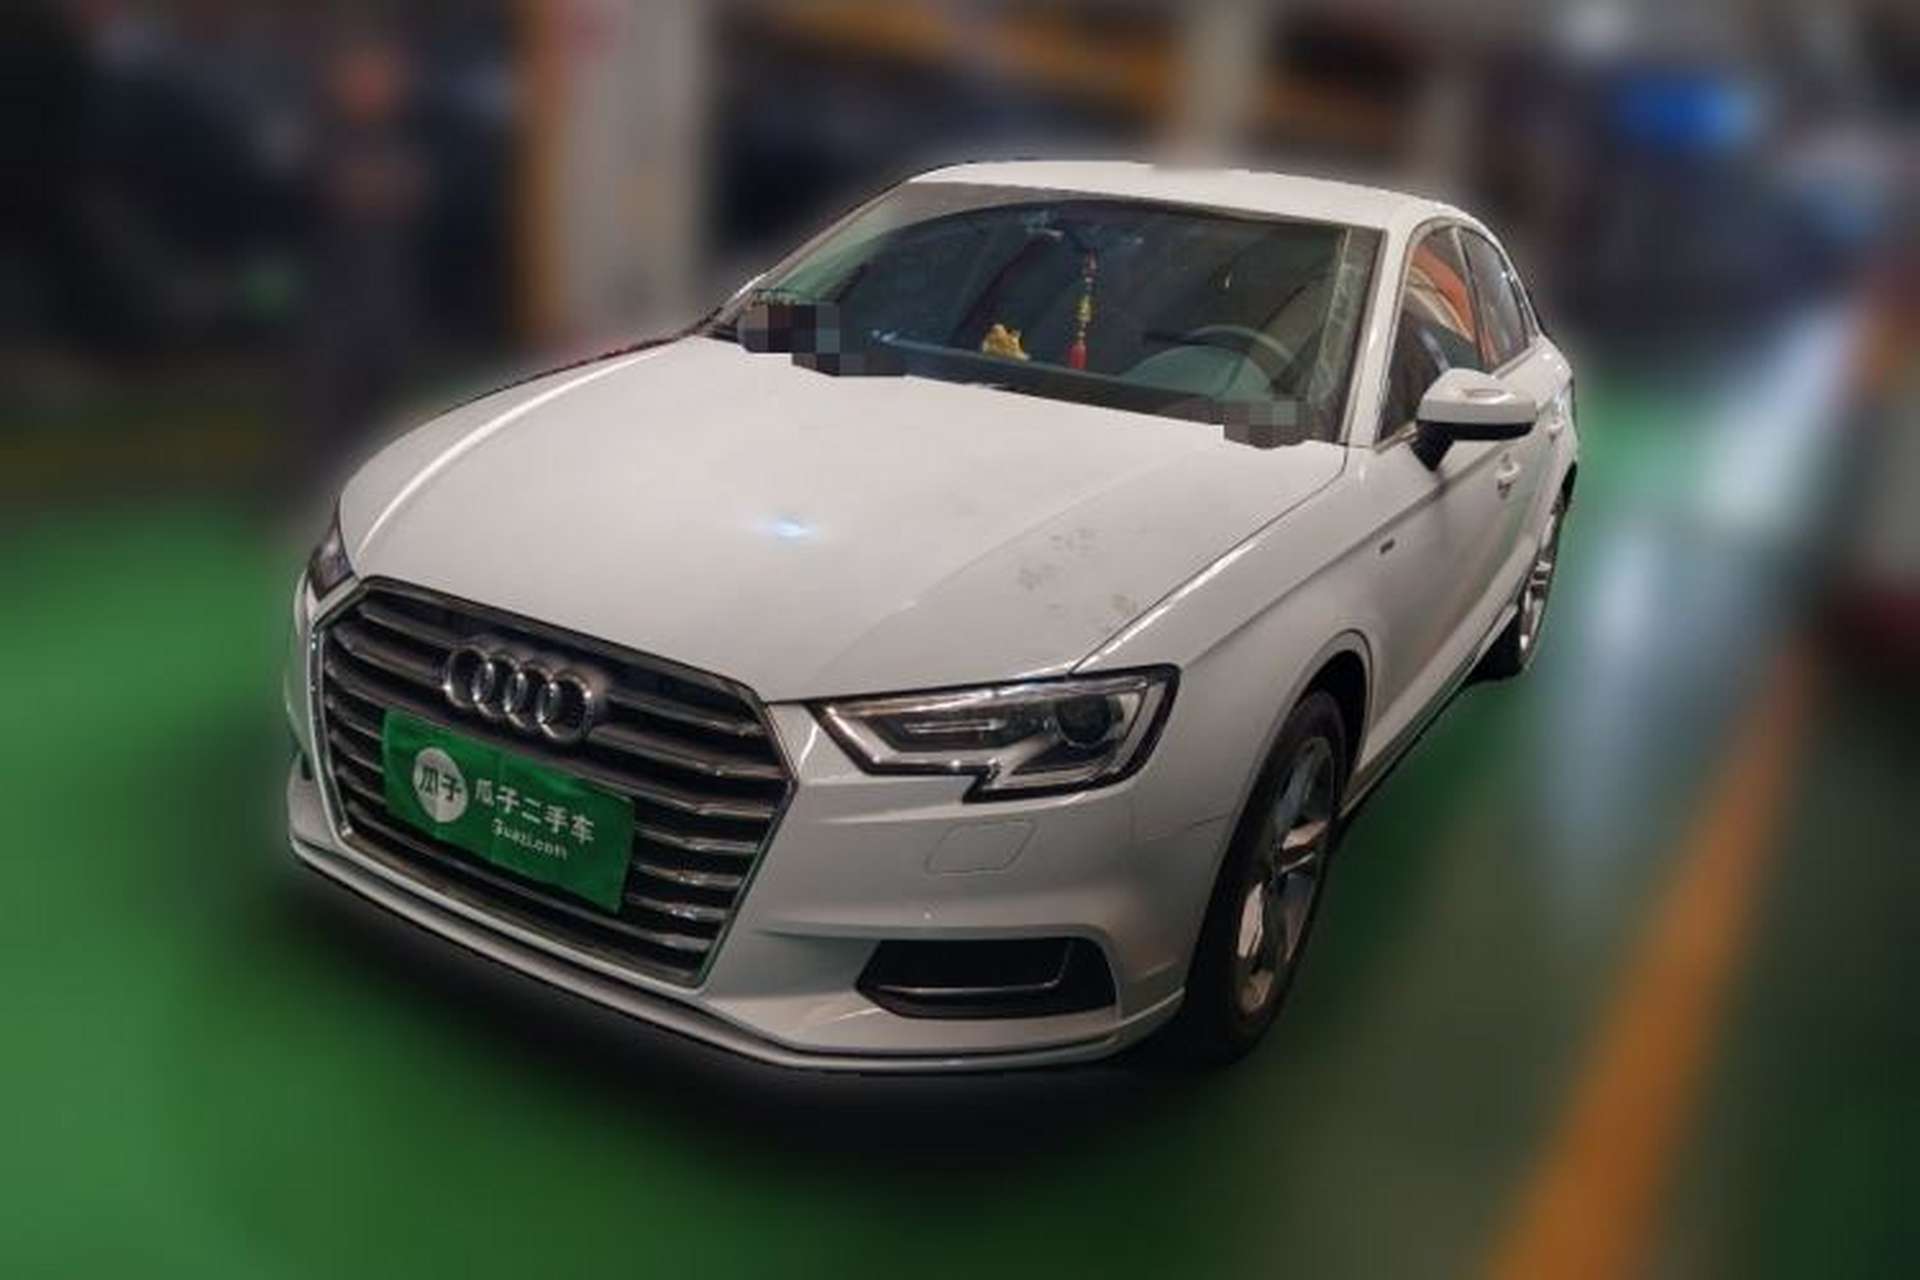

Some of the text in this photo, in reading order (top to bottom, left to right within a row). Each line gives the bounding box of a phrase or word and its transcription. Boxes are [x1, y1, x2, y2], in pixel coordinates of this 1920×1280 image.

[419, 768, 462, 801] 瓜子
[475, 778, 595, 844] 瓜子二手车
